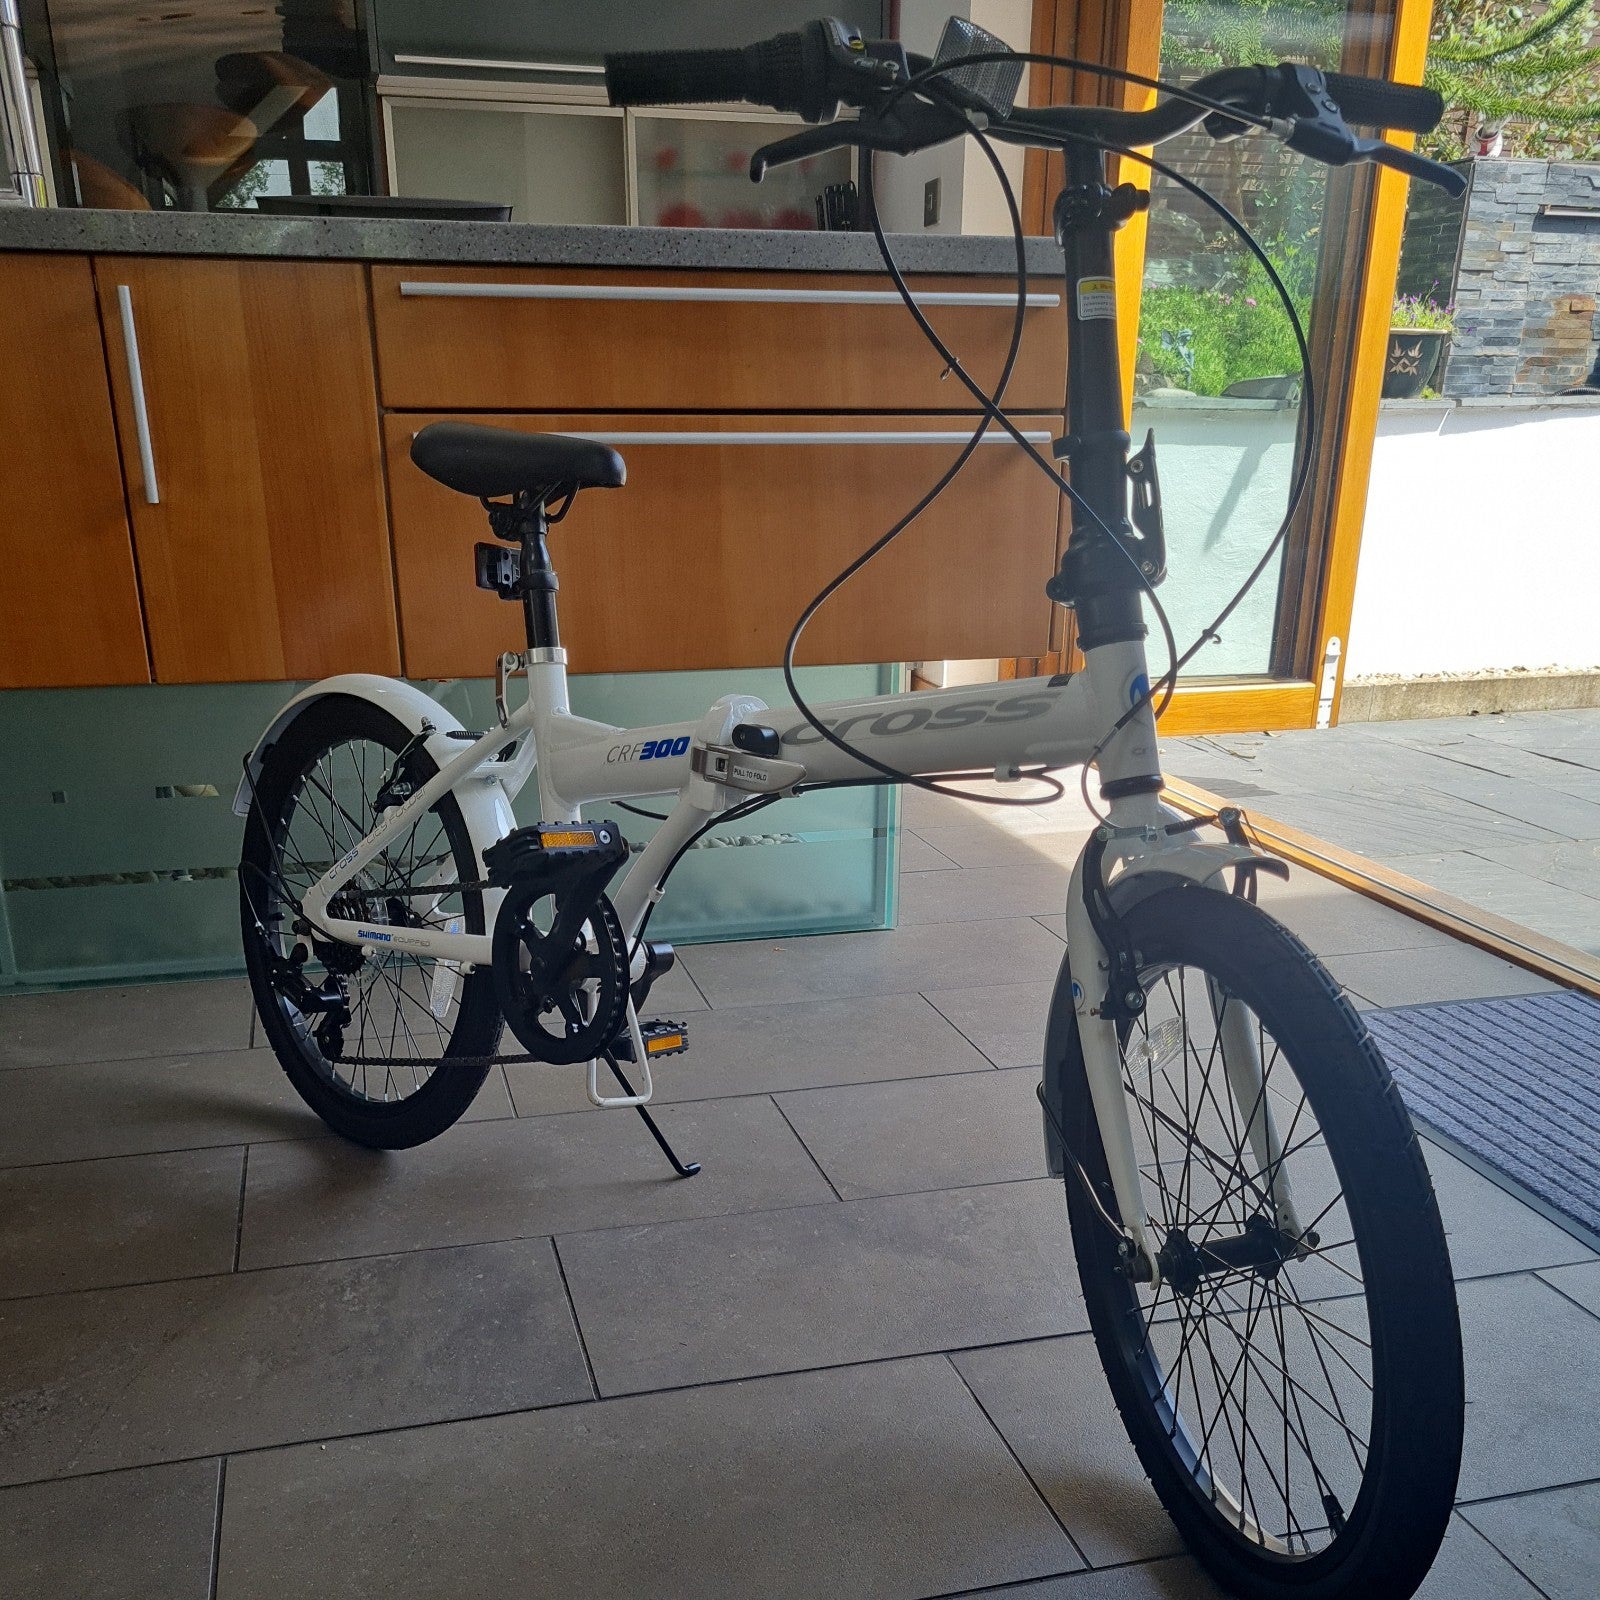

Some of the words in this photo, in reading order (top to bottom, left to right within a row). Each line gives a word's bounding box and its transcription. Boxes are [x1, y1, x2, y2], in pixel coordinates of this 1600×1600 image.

[606, 736, 691, 763] CRF300
[734, 768, 745, 776] PULL
[753, 772, 767, 781] FOLD
[357, 929, 391, 941] SHIMANO
[394, 936, 430, 946] EQUIPPED
